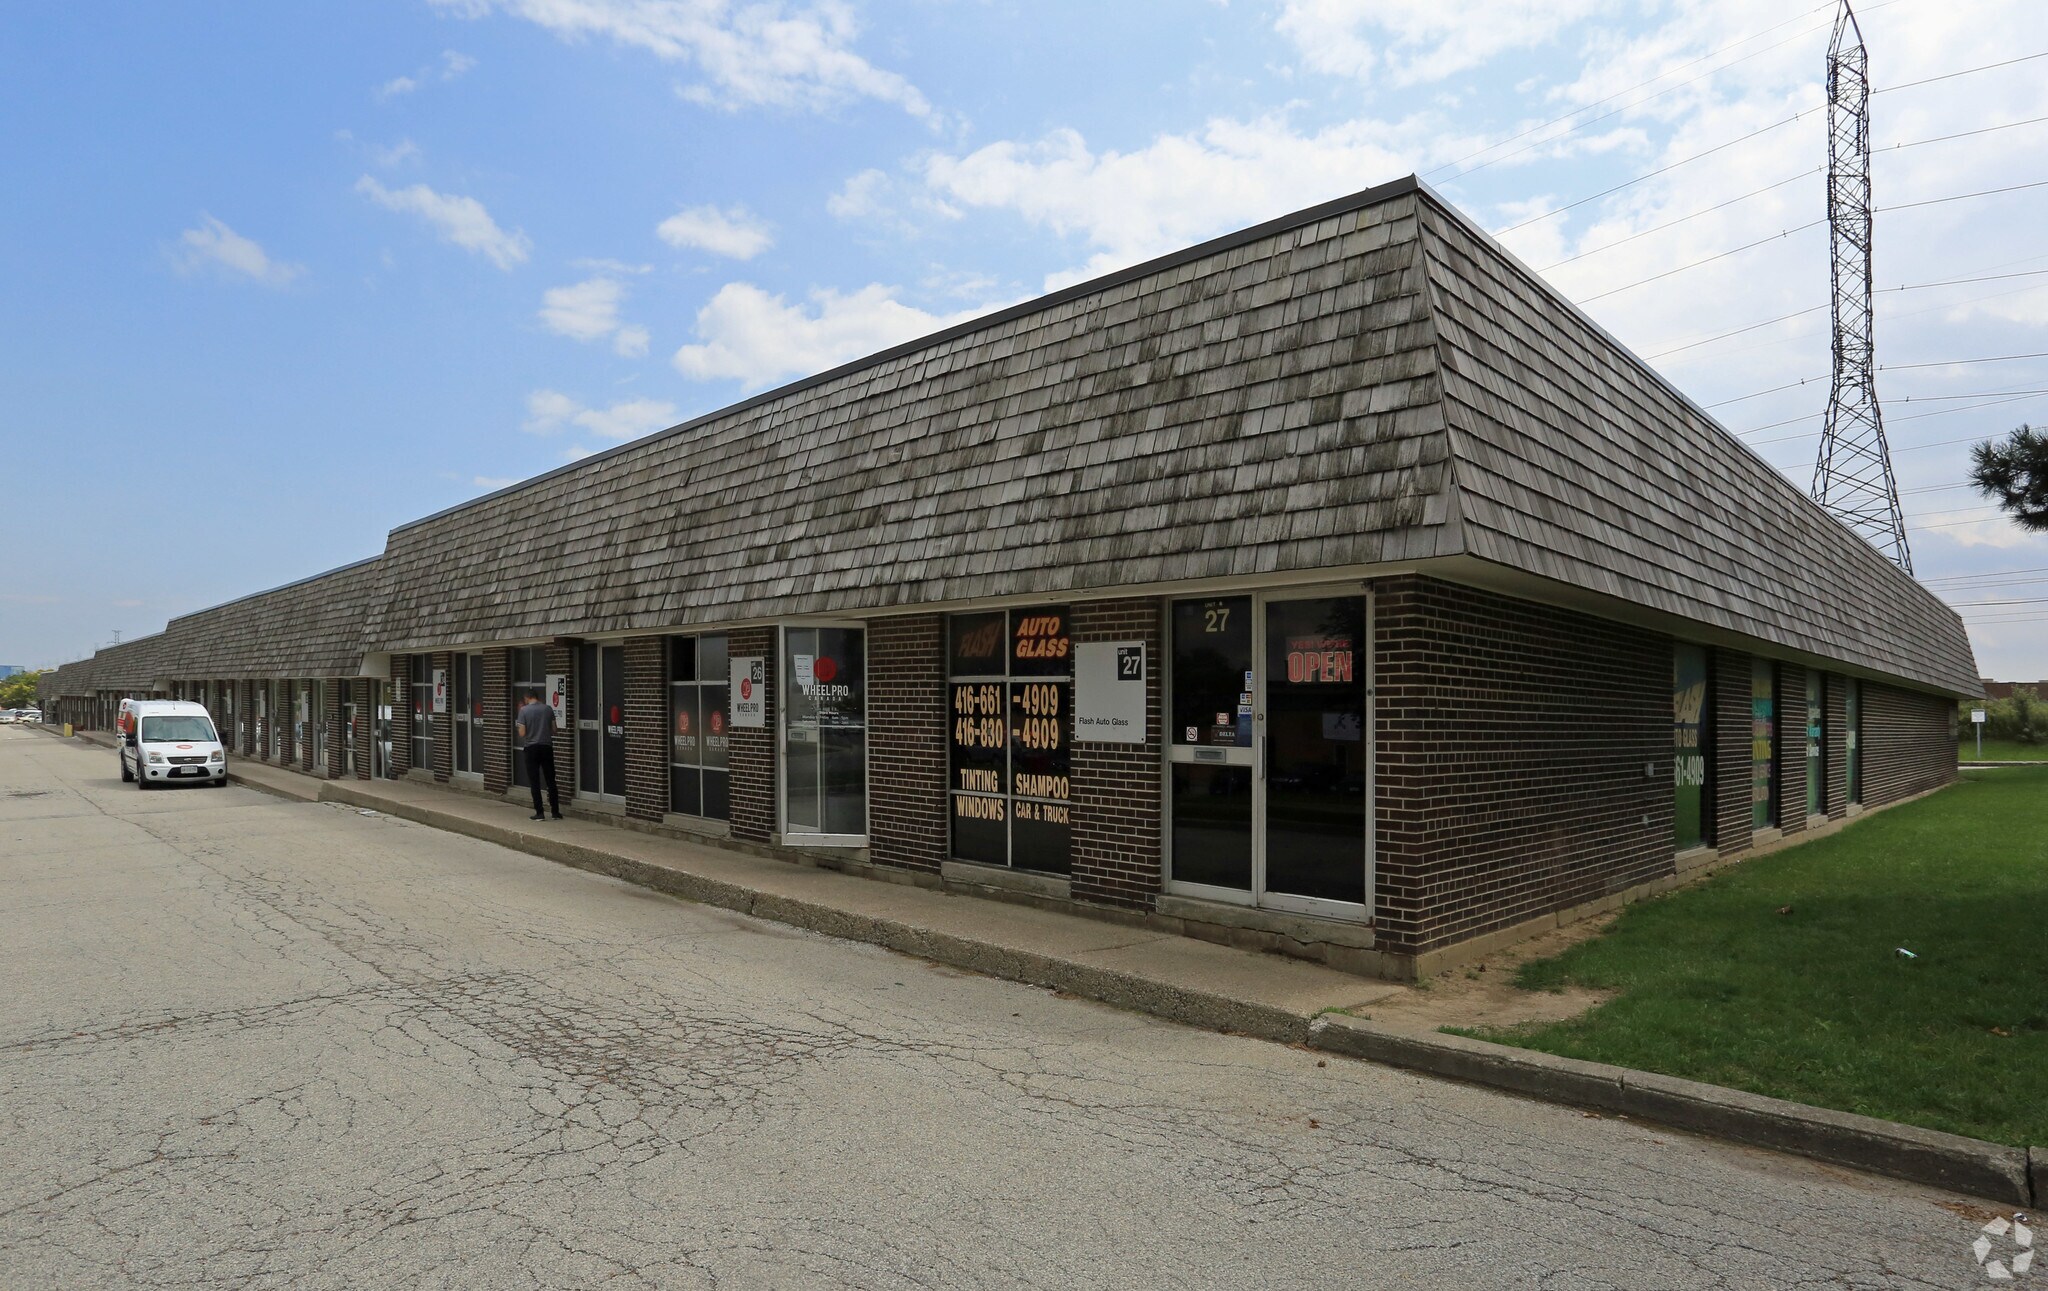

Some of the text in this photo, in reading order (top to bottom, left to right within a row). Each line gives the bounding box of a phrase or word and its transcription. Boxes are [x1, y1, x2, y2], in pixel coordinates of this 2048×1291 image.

[1017, 617, 1060, 636] AUTO
[1205, 608, 1230, 632] 27
[1016, 638, 1069, 657] GLASS
[752, 666, 762, 680] 26
[1123, 656, 1140, 675] 27
[1288, 651, 1352, 682] OPEN
[1079, 717, 1129, 726] Flash Auto Glass
[960, 768, 998, 793] TINTING
[1674, 755, 1704, 787] 61-4909
[1016, 772, 1069, 799] SHAMPOO
[956, 795, 1004, 821] WINDOWS
[1015, 801, 1069, 824] CAR & TRUCK
